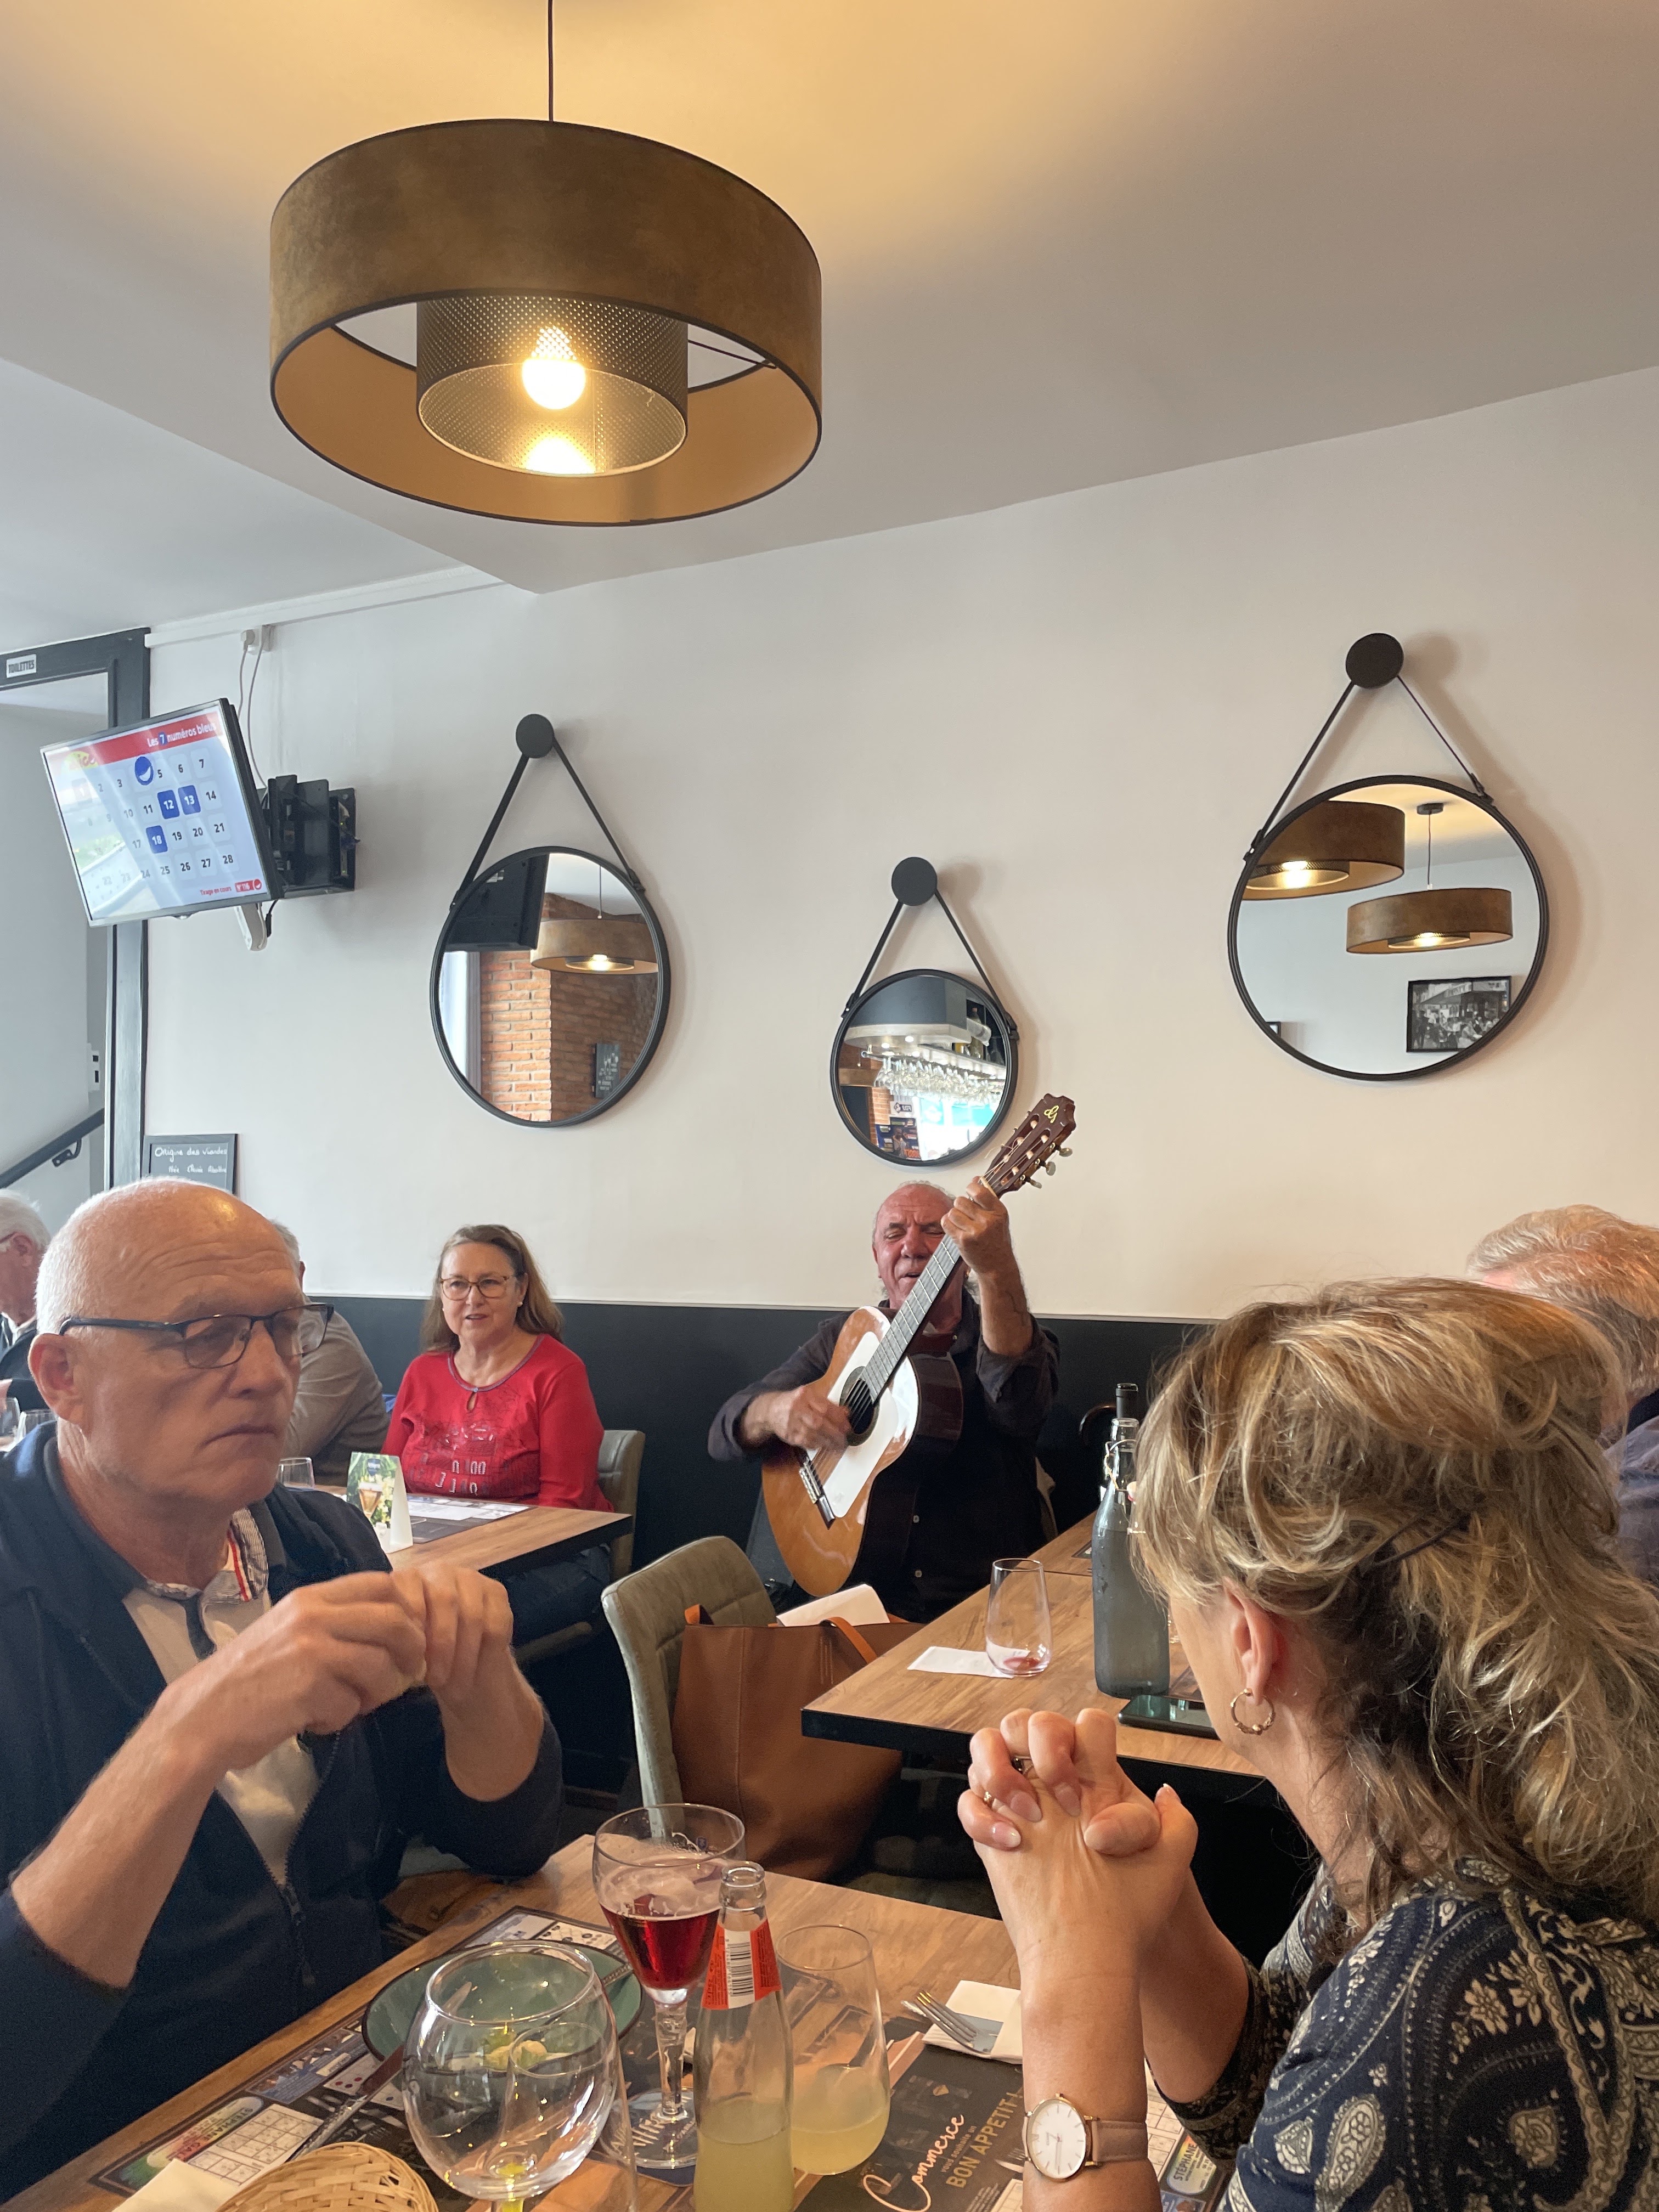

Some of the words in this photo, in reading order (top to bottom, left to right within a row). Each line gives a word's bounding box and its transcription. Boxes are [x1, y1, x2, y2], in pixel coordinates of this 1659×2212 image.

[147, 738, 159, 747] Les
[160, 734, 164, 744] 7
[167, 727, 196, 742] numéros
[196, 723, 216, 735] bleus
[98, 784, 103, 792] 2
[117, 779, 122, 787] 3
[157, 770, 163, 778] 5
[178, 764, 183, 773] 6
[199, 759, 204, 768] 7
[123, 809, 133, 818] 10
[143, 804, 153, 814] 11
[163, 799, 174, 810] 12
[184, 795, 195, 805] 13
[206, 791, 216, 800] 14
[132, 839, 141, 848] 17
[151, 835, 162, 845] 18
[172, 831, 182, 841] 19
[193, 827, 203, 837] 20
[214, 823, 225, 833] 21
[140, 869, 150, 878] 24
[160, 866, 170, 875] 25
[180, 862, 191, 871] 26
[201, 859, 211, 868] 27
[223, 855, 233, 864] 28
[155, 1146, 183, 1163] Origine
[187, 1147, 200, 1156] des
[945, 2157, 981, 2189] BON
[969, 2098, 1018, 2156] APPETIT
[863, 2114, 964, 2212] Commerce
[940, 2159, 955, 2172] vous
